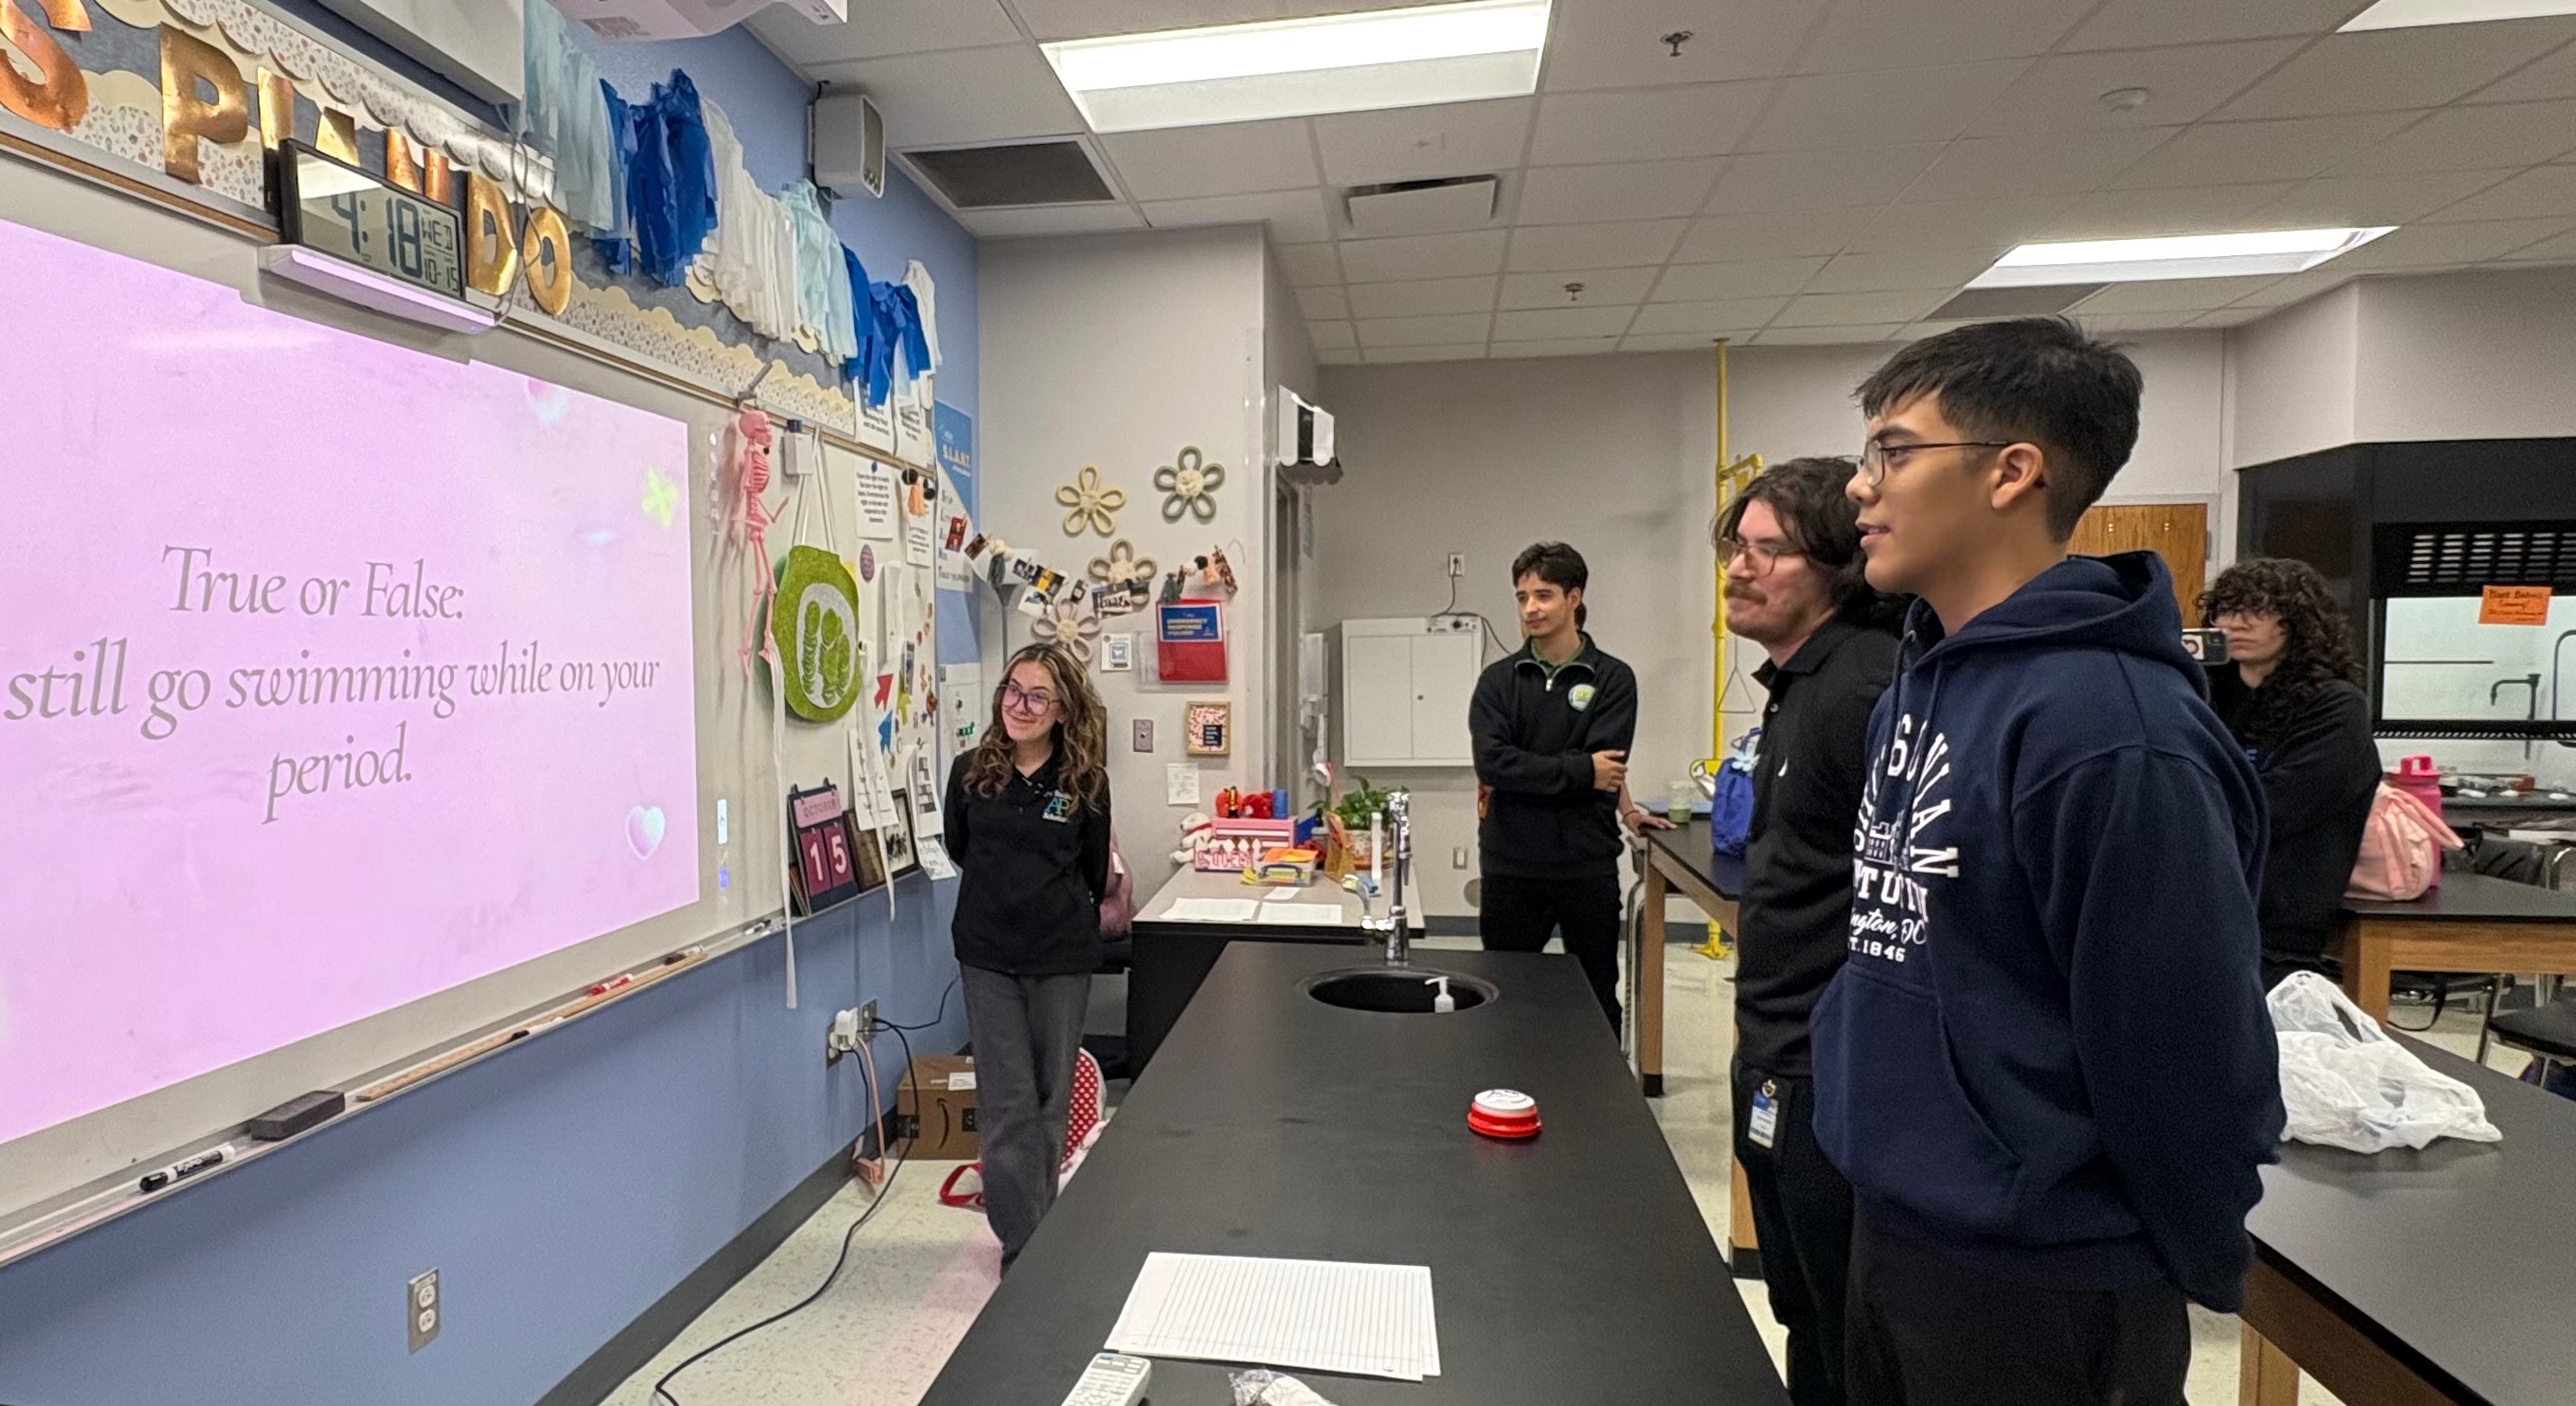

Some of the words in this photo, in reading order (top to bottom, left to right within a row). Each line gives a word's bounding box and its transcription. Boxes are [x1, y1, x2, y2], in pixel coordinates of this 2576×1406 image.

[331, 191, 423, 279] 4:18
[421, 217, 454, 251] WED
[163, 544, 287, 615] True
[298, 575, 351, 617] or
[359, 558, 465, 620] False:
[4, 637, 129, 722] still
[140, 661, 212, 740] go
[225, 649, 459, 720] swimming
[466, 640, 553, 697] while
[559, 664, 595, 693] on
[597, 656, 661, 708] your
[261, 721, 413, 826] period.
[809, 835, 847, 881] 15
[1847, 935, 1907, 963] T.1846
